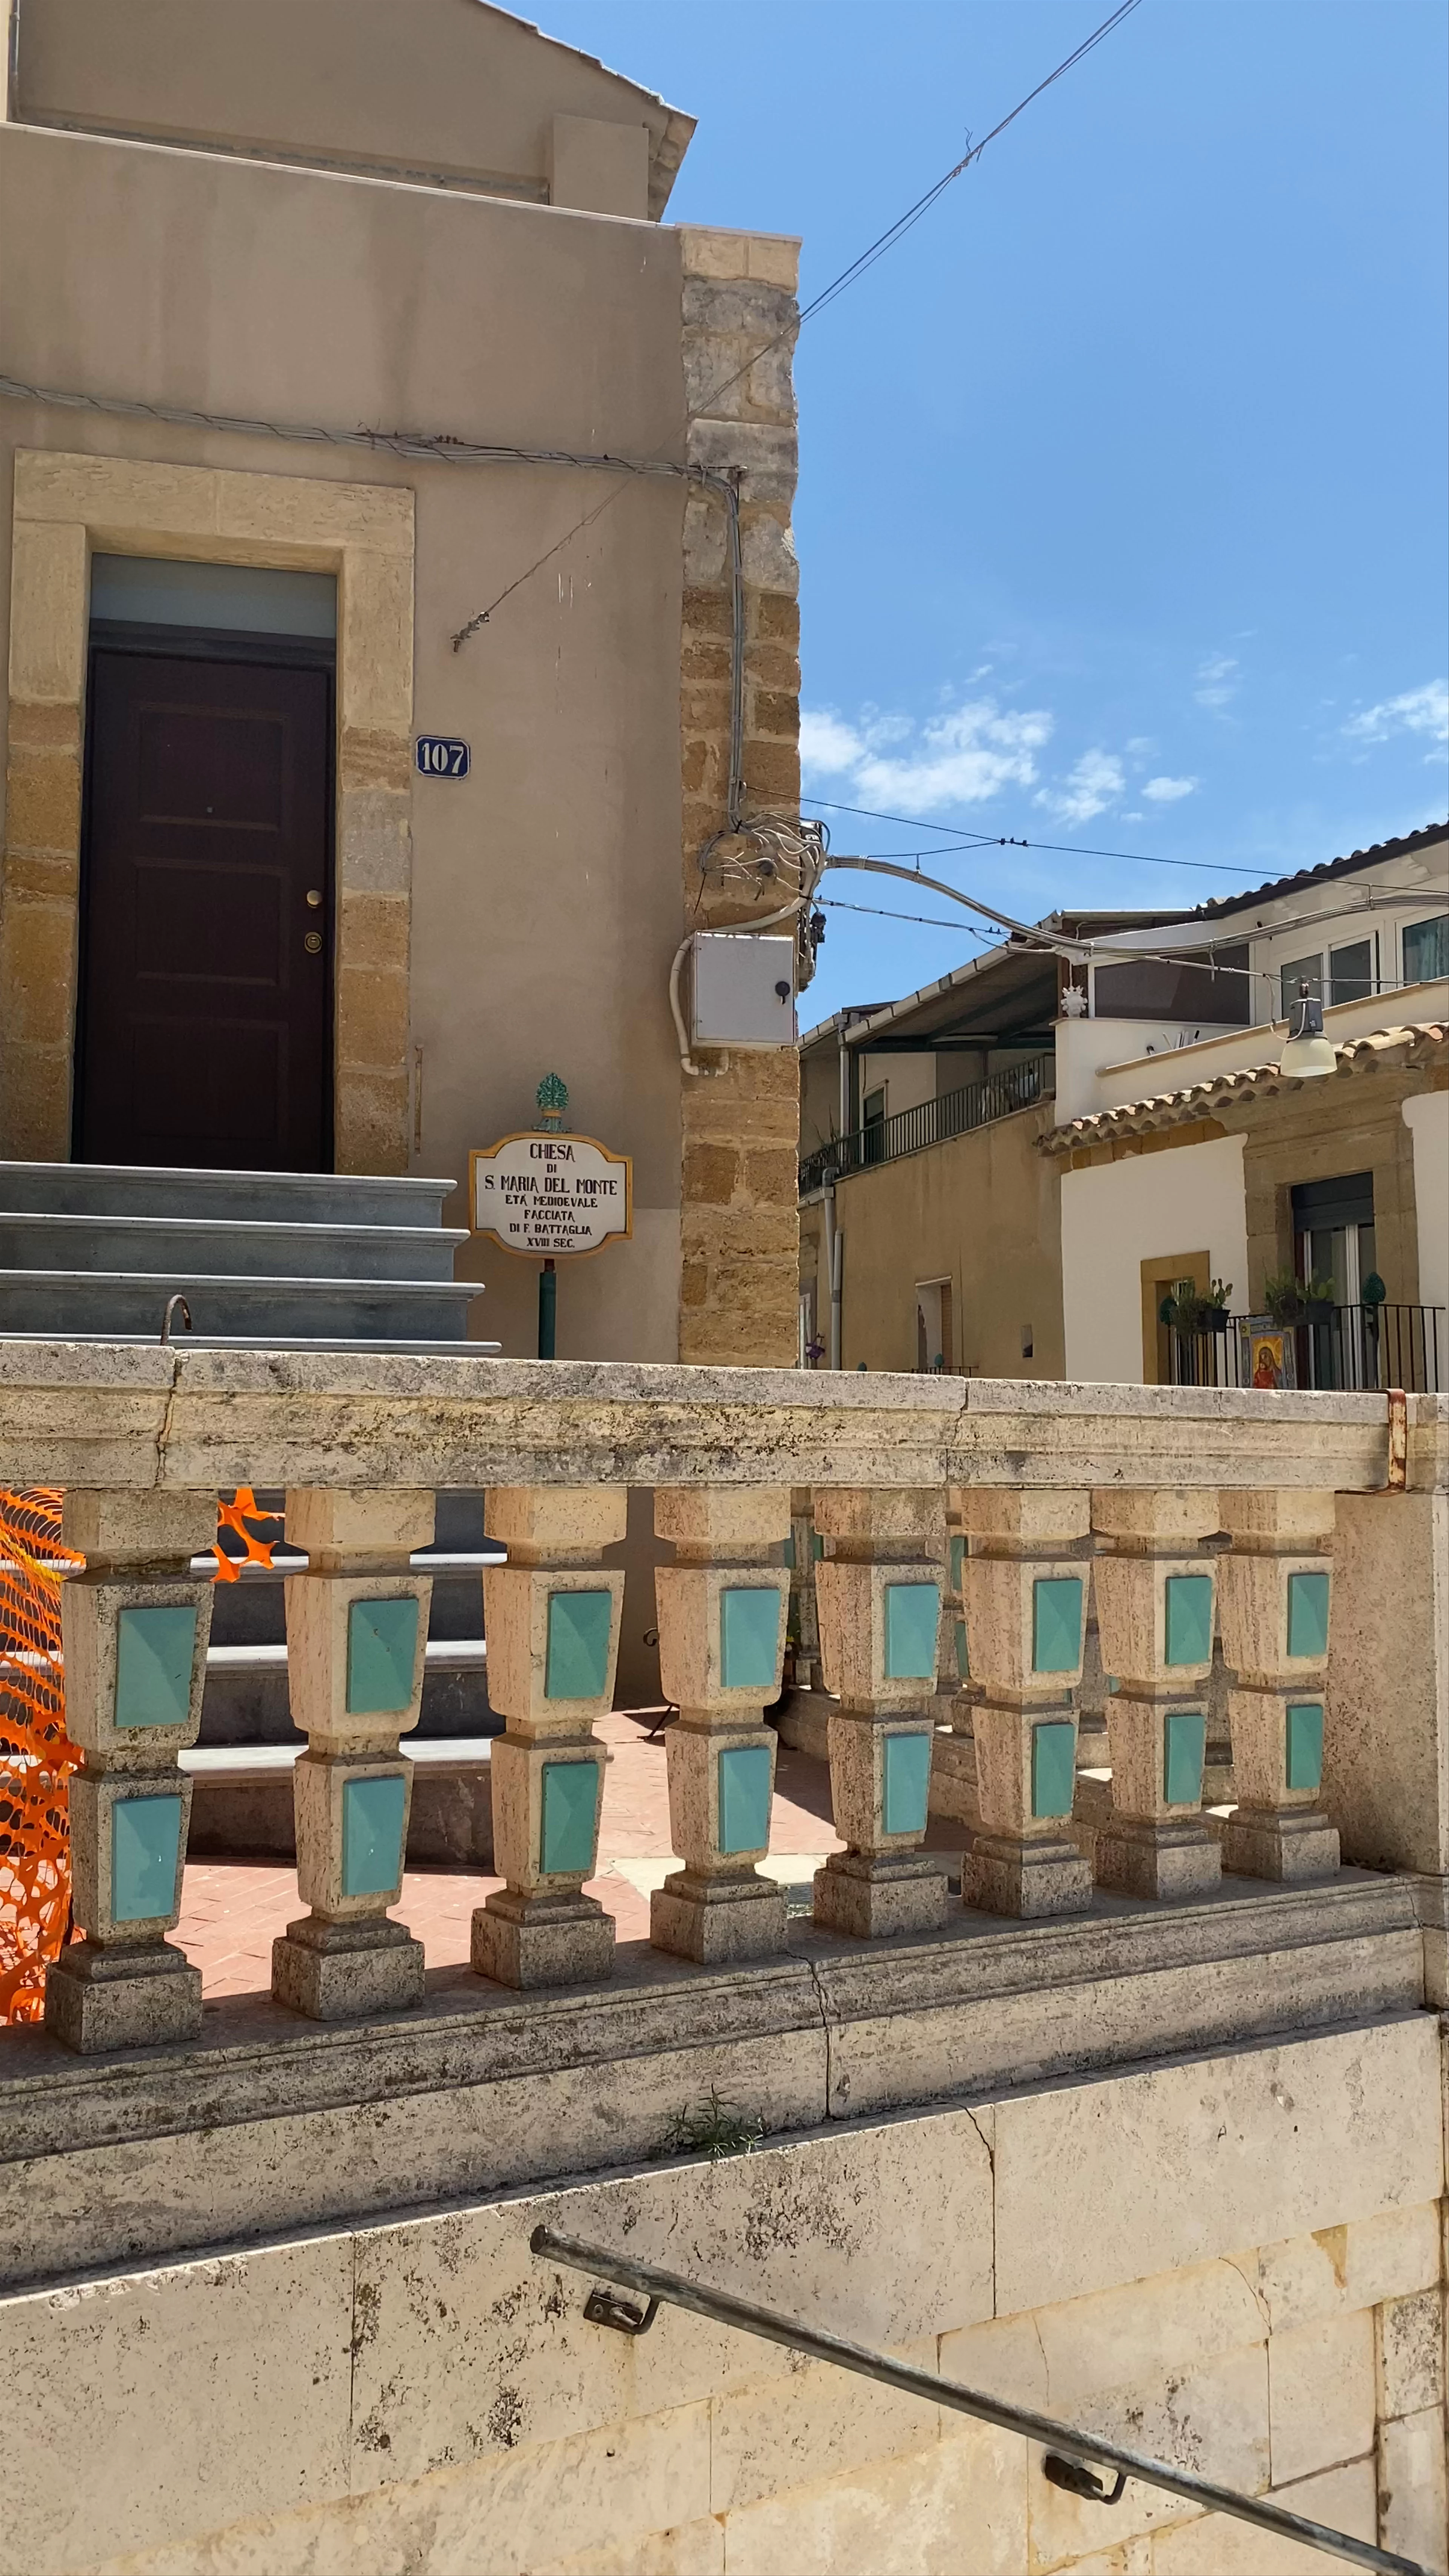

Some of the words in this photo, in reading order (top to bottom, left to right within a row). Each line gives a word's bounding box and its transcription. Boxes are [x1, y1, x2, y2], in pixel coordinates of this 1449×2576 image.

[422, 743, 464, 774] 107
[530, 1143, 575, 1162] CHIESA
[547, 1164, 557, 1173] DI
[485, 1175, 495, 1190] S.
[501, 1176, 539, 1193] MARIA
[544, 1177, 570, 1193] DEL
[576, 1179, 617, 1195] MONTE
[533, 1195, 598, 1208] MEDIOEVALE
[524, 1209, 575, 1222] FACCIATA
[509, 1223, 520, 1233] DI
[523, 1224, 531, 1233] F.
[535, 1224, 592, 1235] BATTAGLIA
[526, 1237, 550, 1247] XVIII
[554, 1238, 575, 1248] SEC.
